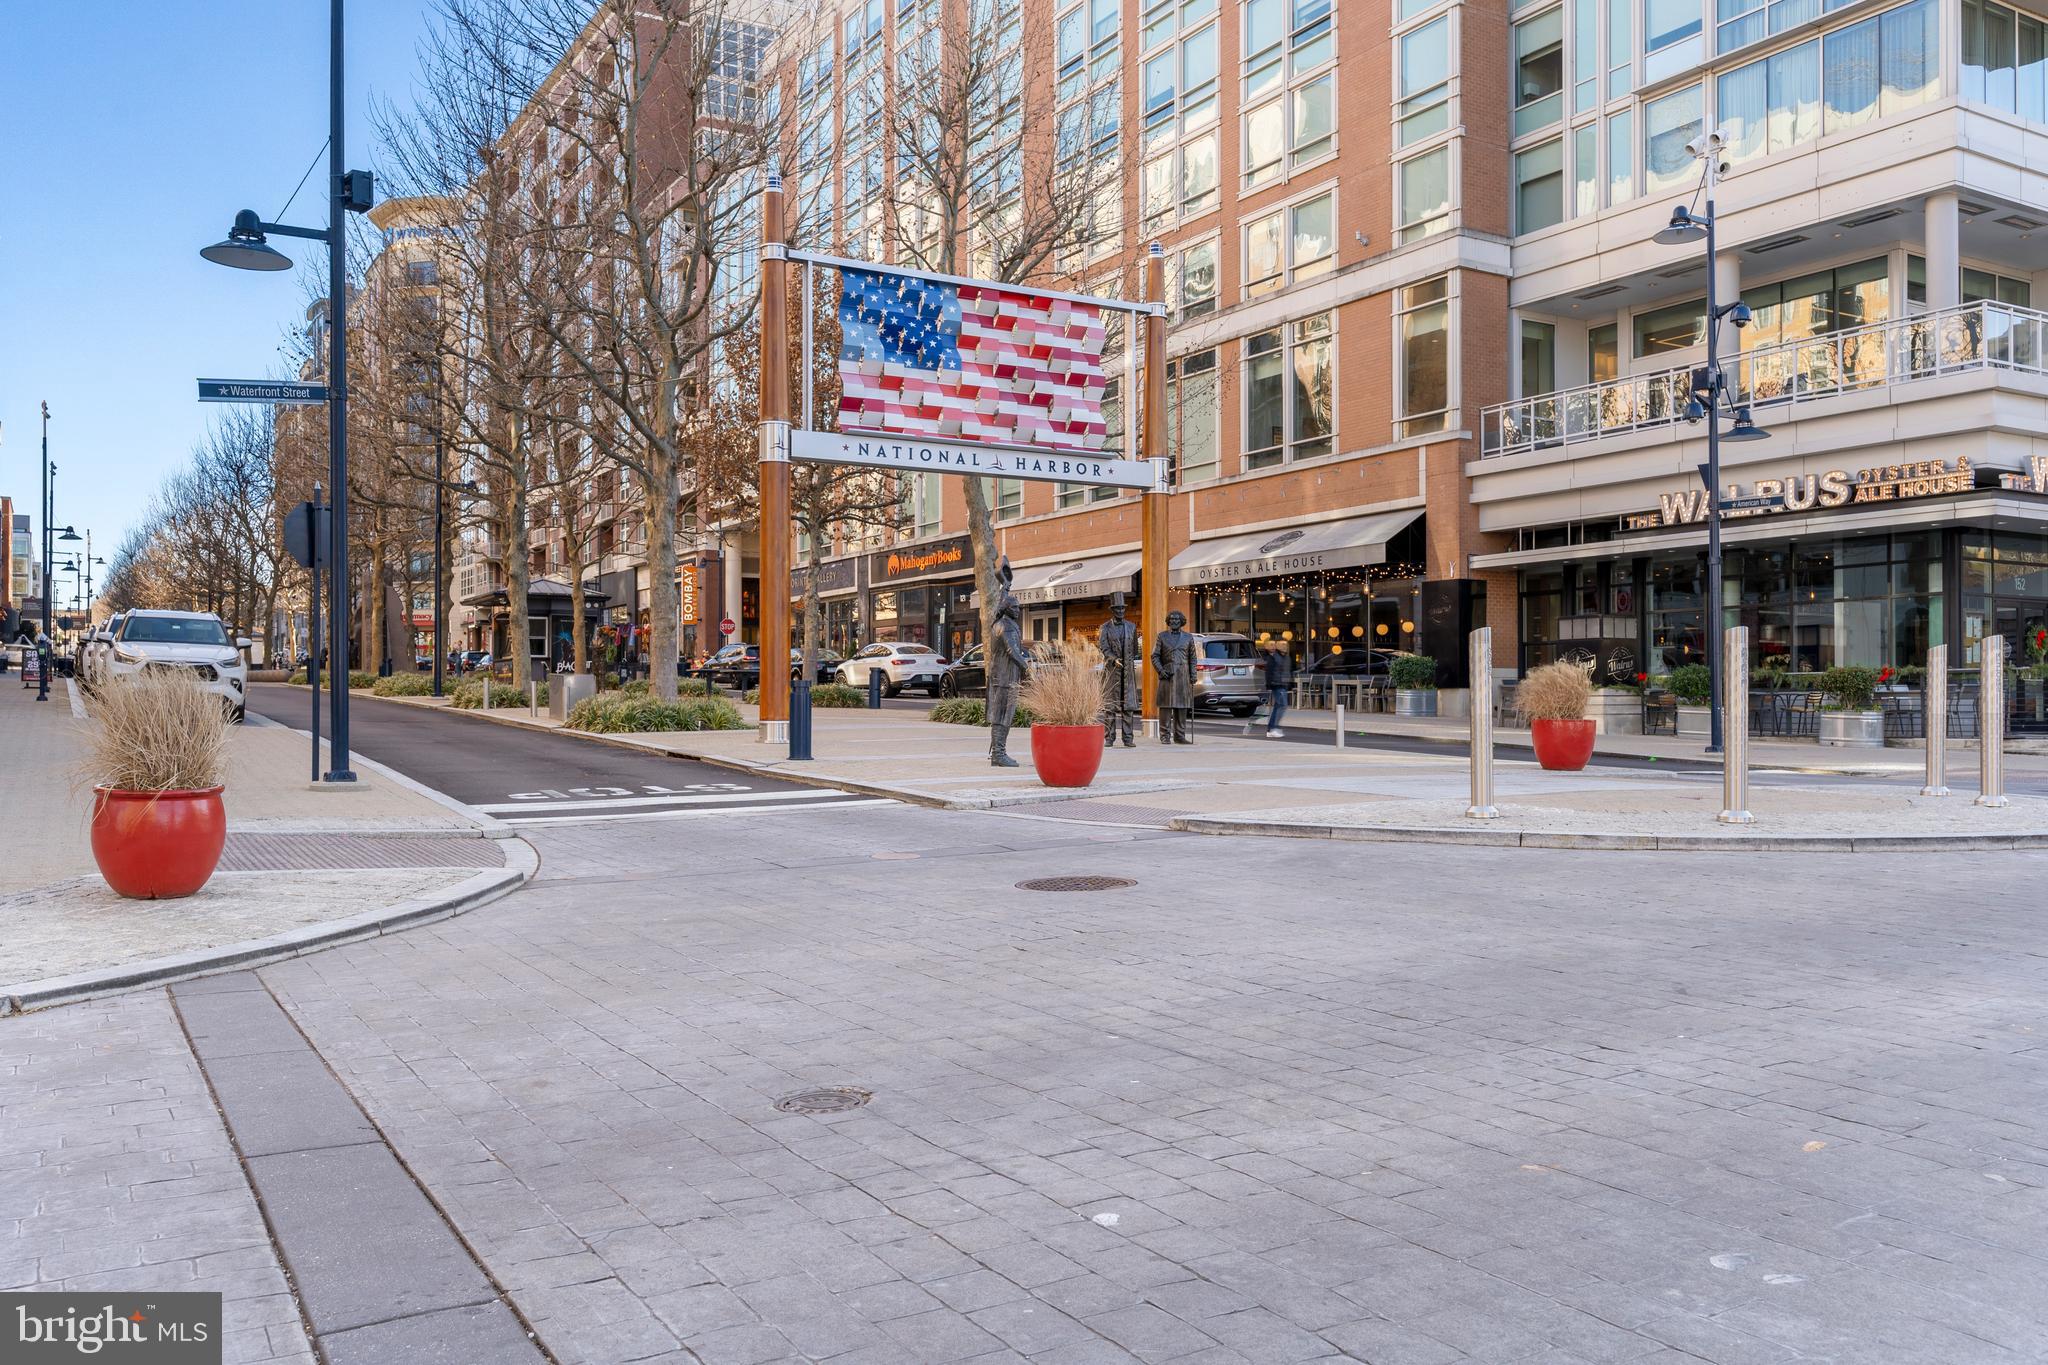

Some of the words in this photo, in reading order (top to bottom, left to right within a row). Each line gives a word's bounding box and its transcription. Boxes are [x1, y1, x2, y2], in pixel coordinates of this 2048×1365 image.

[230, 385, 280, 397] Waterfront
[283, 386, 311, 398] Street
[858, 442, 980, 467] NATIONAL
[1016, 457, 1101, 476] HARBOR
[1856, 459, 1945, 484] OYSTER
[1957, 455, 1971, 472] &
[1854, 484, 1894, 503] ALE
[1899, 474, 1975, 498] HOUSE
[1737, 499, 1760, 508] American
[1760, 498, 1772, 506] Way
[1626, 513, 1662, 529] THE
[900, 547, 962, 570] MahoganyBooks
[1200, 566, 1239, 579] OYSTER
[1245, 564, 1252, 574] &
[1258, 561, 1277, 573] ALE
[1284, 555, 1323, 569] HOUSE
[684, 569, 693, 621] BOMBAY
[1043, 588, 1058, 599] ALE
[1062, 584, 1089, 596] HOUSE
[2014, 577, 2026, 591] 152
